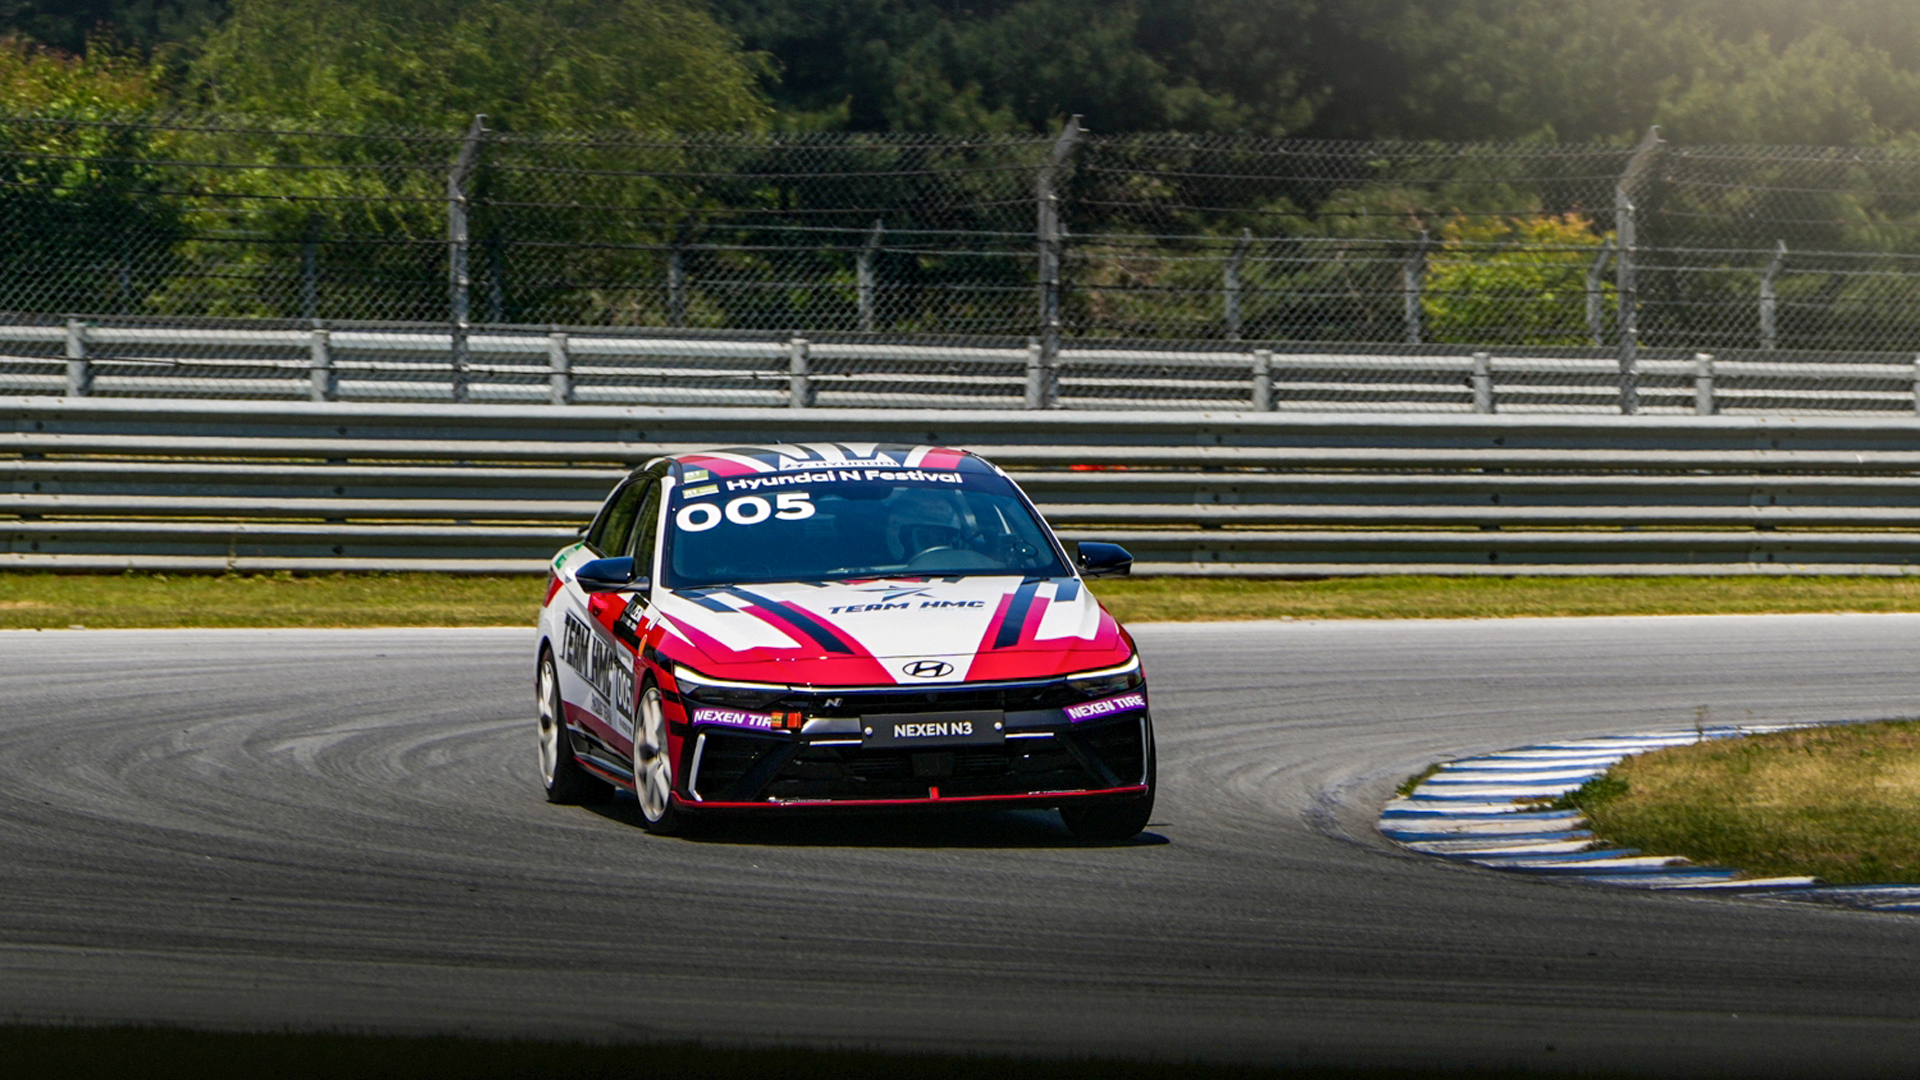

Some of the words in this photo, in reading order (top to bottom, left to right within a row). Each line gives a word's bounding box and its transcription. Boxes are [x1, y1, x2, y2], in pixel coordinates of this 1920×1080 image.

[726, 470, 836, 491] Hyundai
[839, 470, 861, 482] N
[865, 469, 963, 484] Festival
[676, 492, 815, 532] 005
[828, 602, 910, 615] TEAM
[920, 600, 985, 609] HMC
[1068, 700, 1116, 719] NEXEN
[1113, 695, 1145, 709] TIRE
[694, 710, 746, 724] NEXEN
[748, 714, 772, 728] TIR
[894, 722, 948, 738] NEXEN
[951, 721, 973, 736] N3
